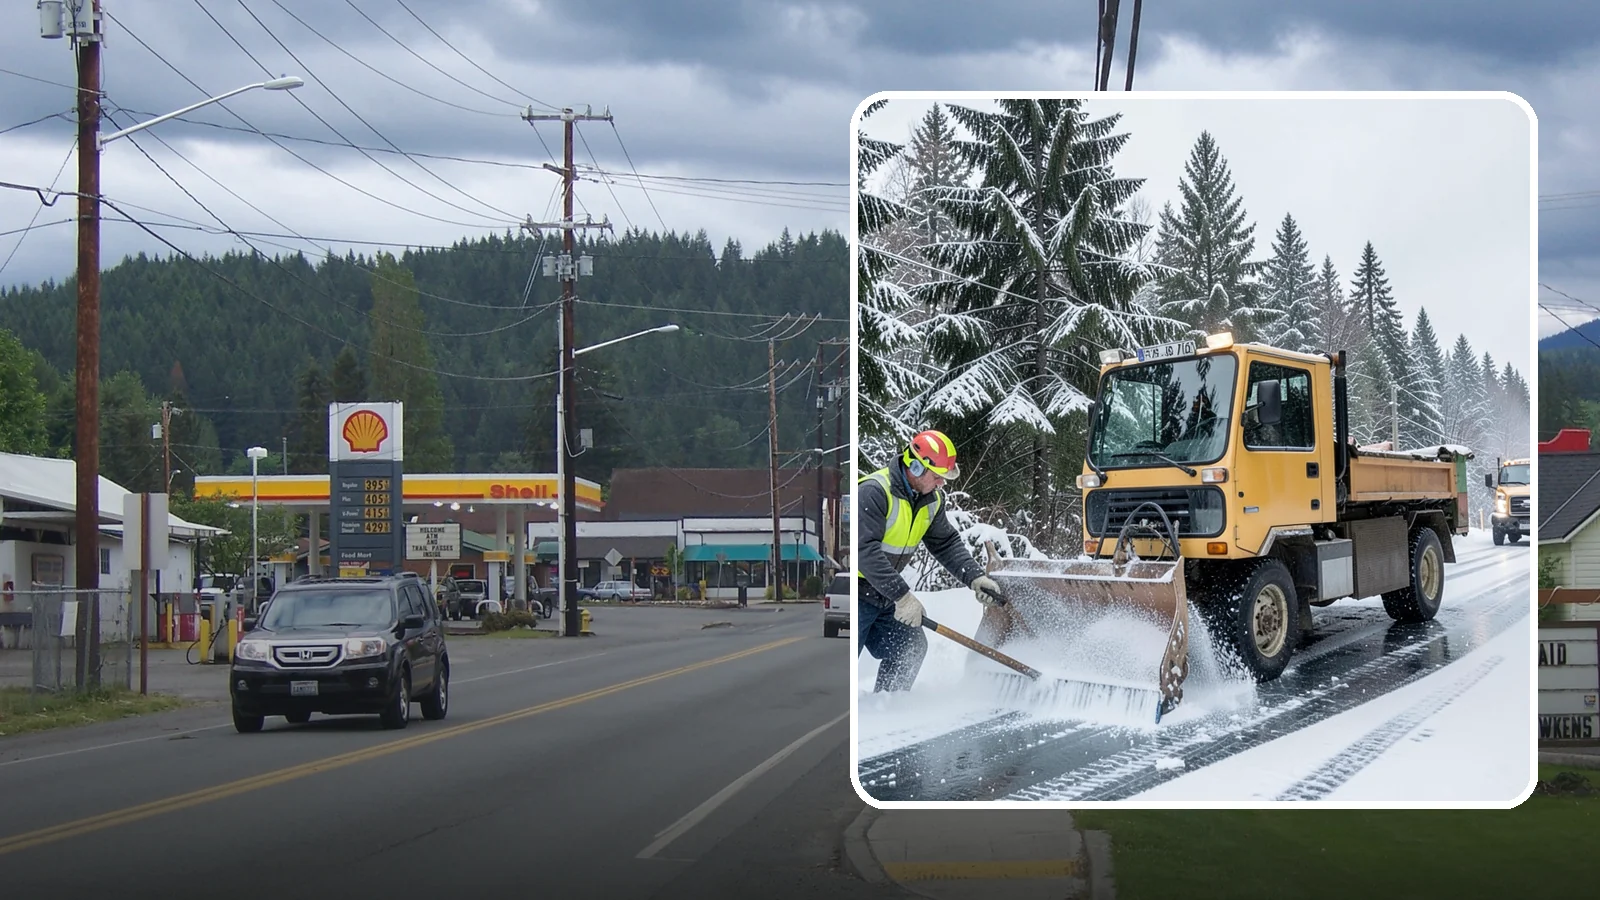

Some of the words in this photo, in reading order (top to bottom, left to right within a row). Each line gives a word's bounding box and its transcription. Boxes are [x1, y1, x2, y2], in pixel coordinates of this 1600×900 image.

[366, 480, 383, 490] 395
[490, 484, 547, 499] Shell
[366, 494, 383, 504] 405
[366, 508, 383, 518] 415
[366, 522, 383, 532] 429
